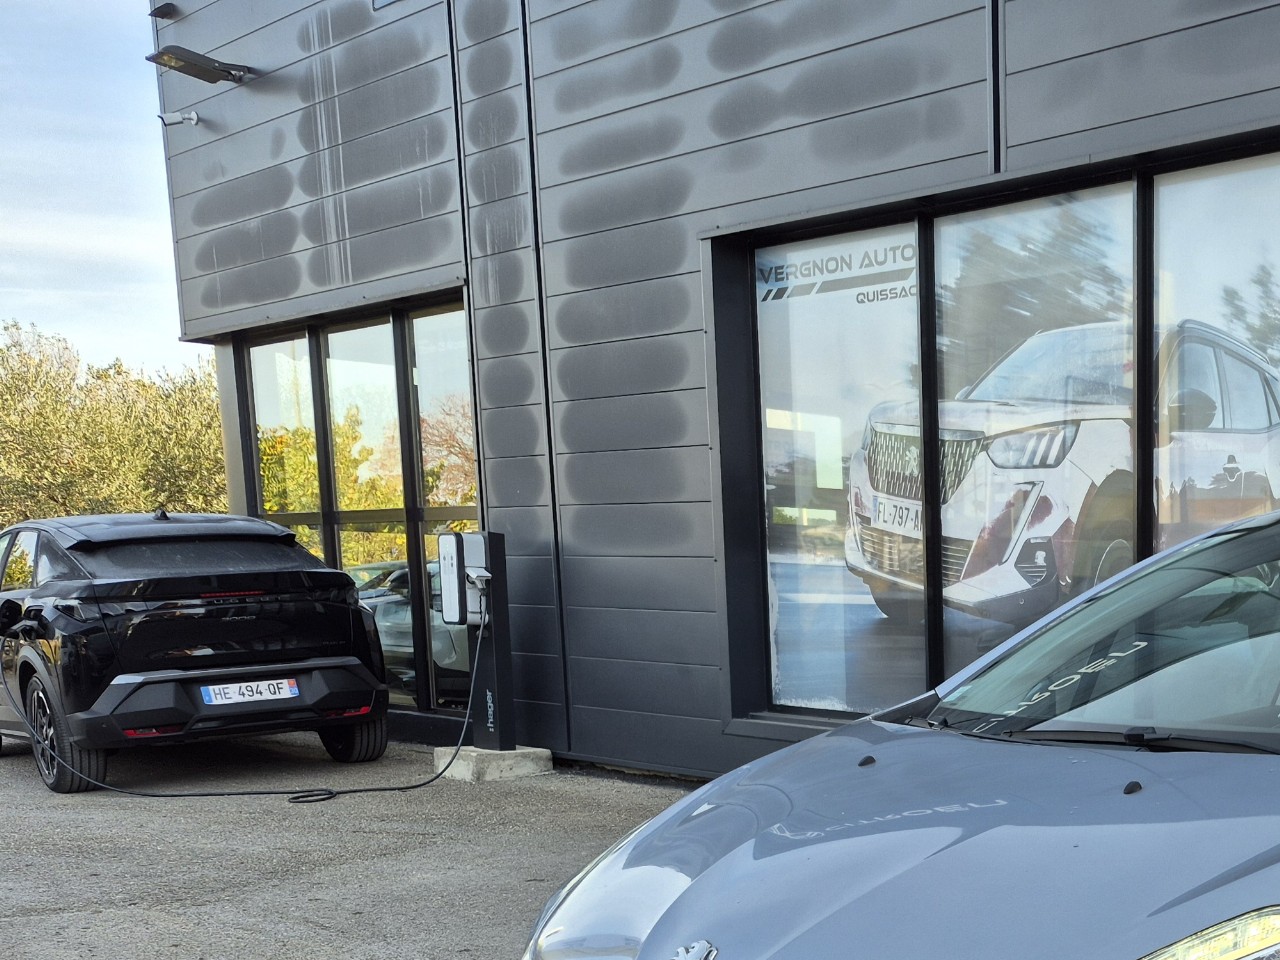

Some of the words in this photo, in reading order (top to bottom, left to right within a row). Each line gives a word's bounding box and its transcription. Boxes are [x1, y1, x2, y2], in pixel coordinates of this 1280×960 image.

[758, 253, 853, 284] VERGNON
[859, 243, 917, 269] AUTO
[856, 284, 918, 304] QUISSAC
